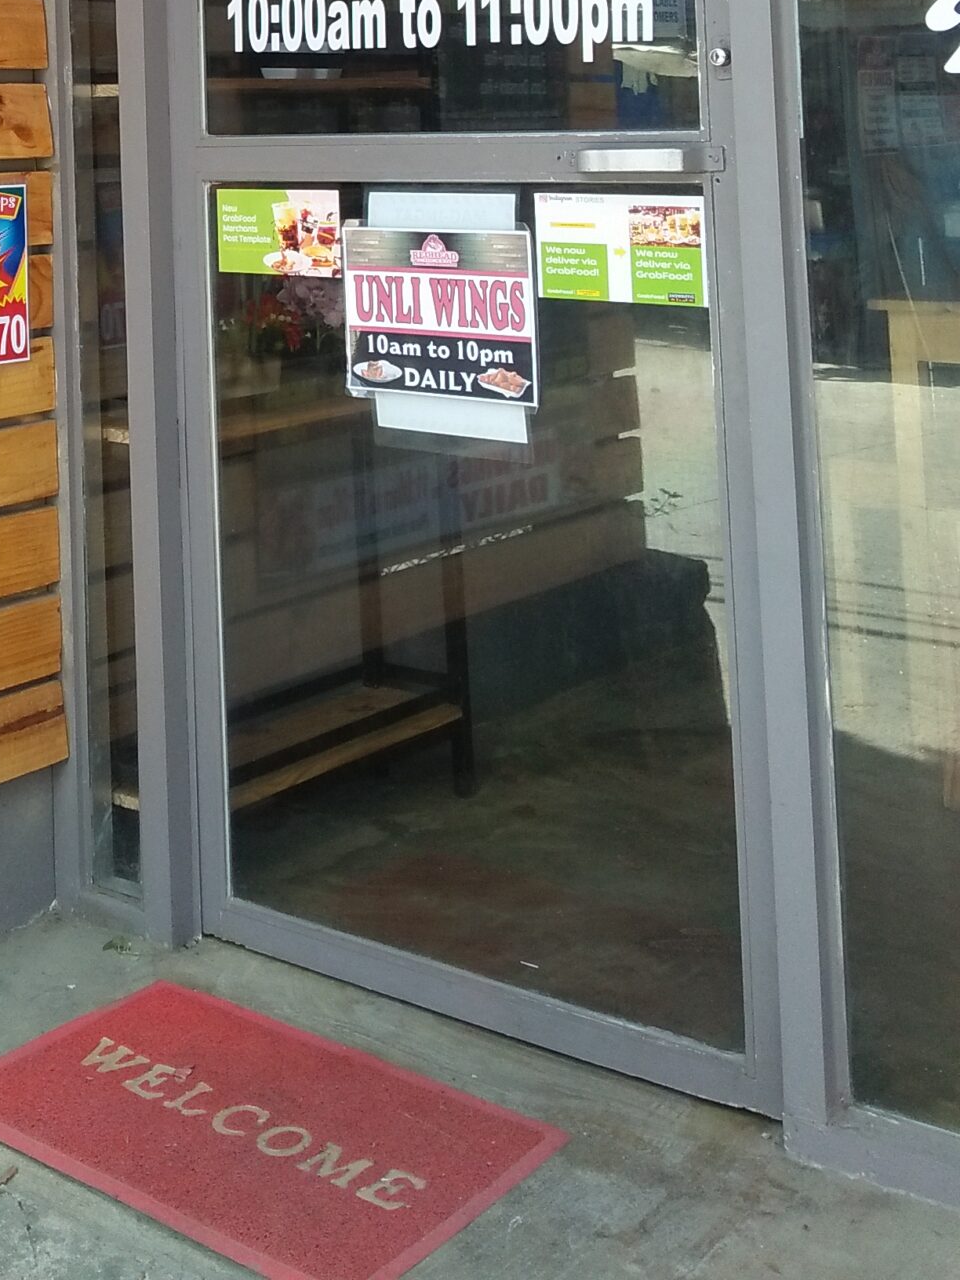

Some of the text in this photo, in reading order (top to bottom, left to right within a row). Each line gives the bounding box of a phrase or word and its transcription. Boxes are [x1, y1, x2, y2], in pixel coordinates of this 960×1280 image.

[546, 246, 562, 254] We
[546, 256, 580, 265] deliver
[546, 268, 599, 277] GrabFood!
[354, 275, 525, 332] UNLI WINGS
[367, 335, 514, 366] 10am to 10pm
[404, 368, 477, 392] DAILY
[79, 1036, 427, 1211] WELCOME
